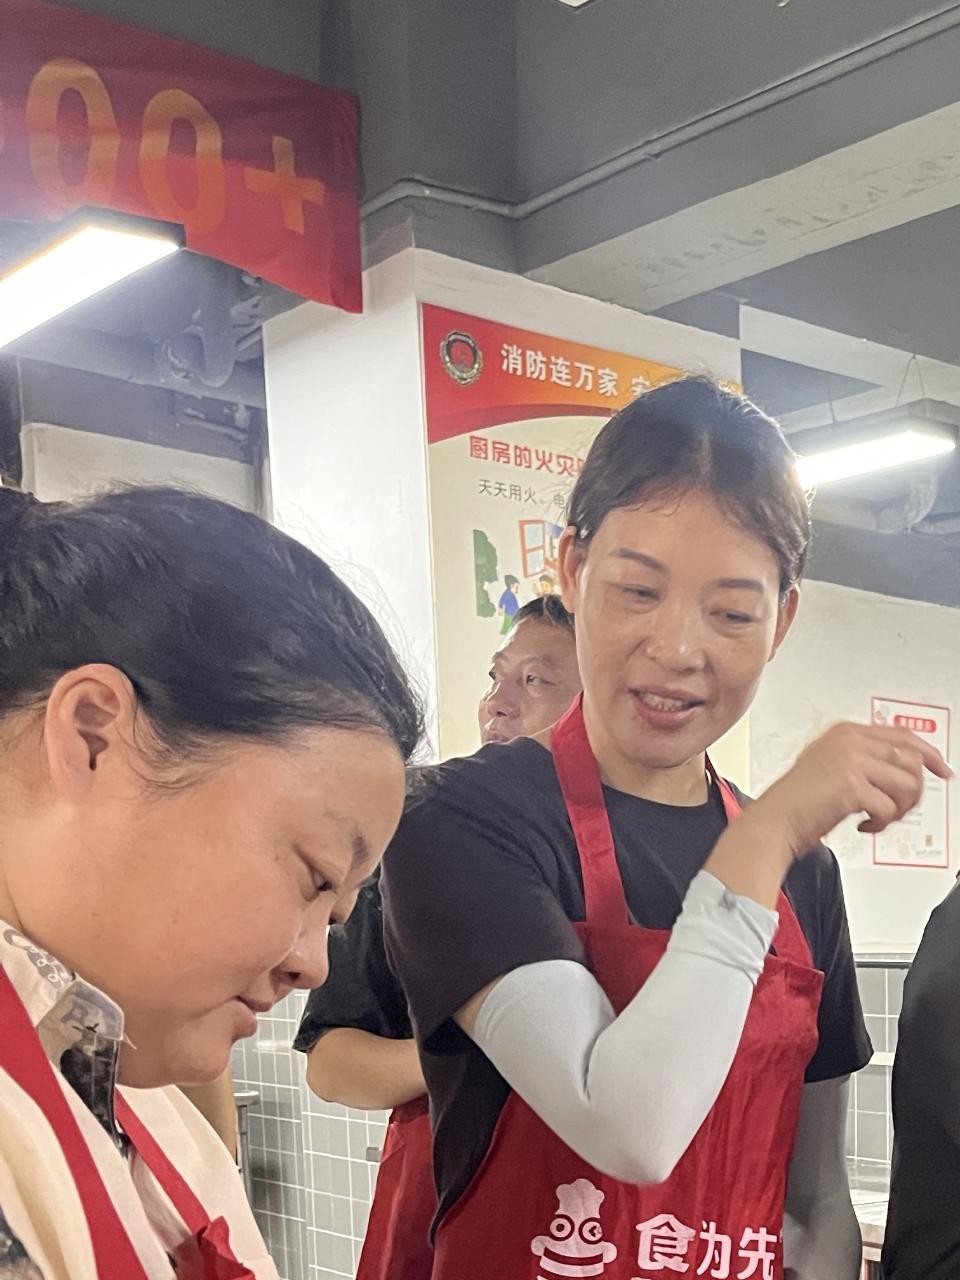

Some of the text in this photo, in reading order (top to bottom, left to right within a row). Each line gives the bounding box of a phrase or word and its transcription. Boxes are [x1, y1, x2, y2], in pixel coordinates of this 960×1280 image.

[501, 343, 619, 397] 消防连万家
